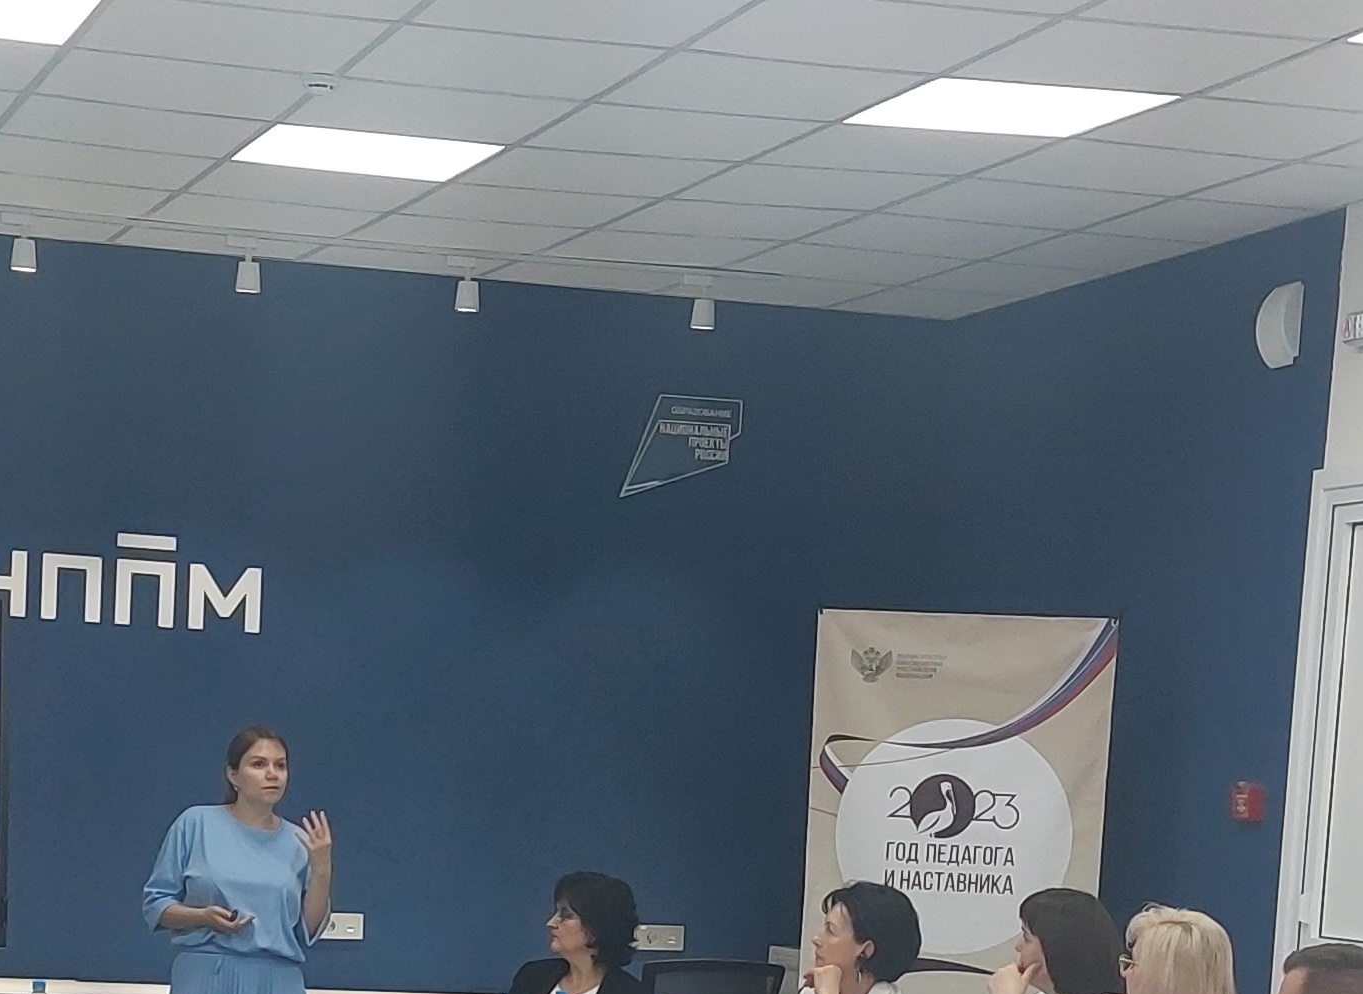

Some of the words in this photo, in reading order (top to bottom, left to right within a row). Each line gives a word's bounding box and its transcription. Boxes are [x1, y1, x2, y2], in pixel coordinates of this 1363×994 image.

[885, 841, 920, 865] ГОД
[925, 843, 1015, 867] ПЕДАГОГА
[884, 868, 896, 888] И
[899, 869, 1015, 895] НАСТАВНИКА
